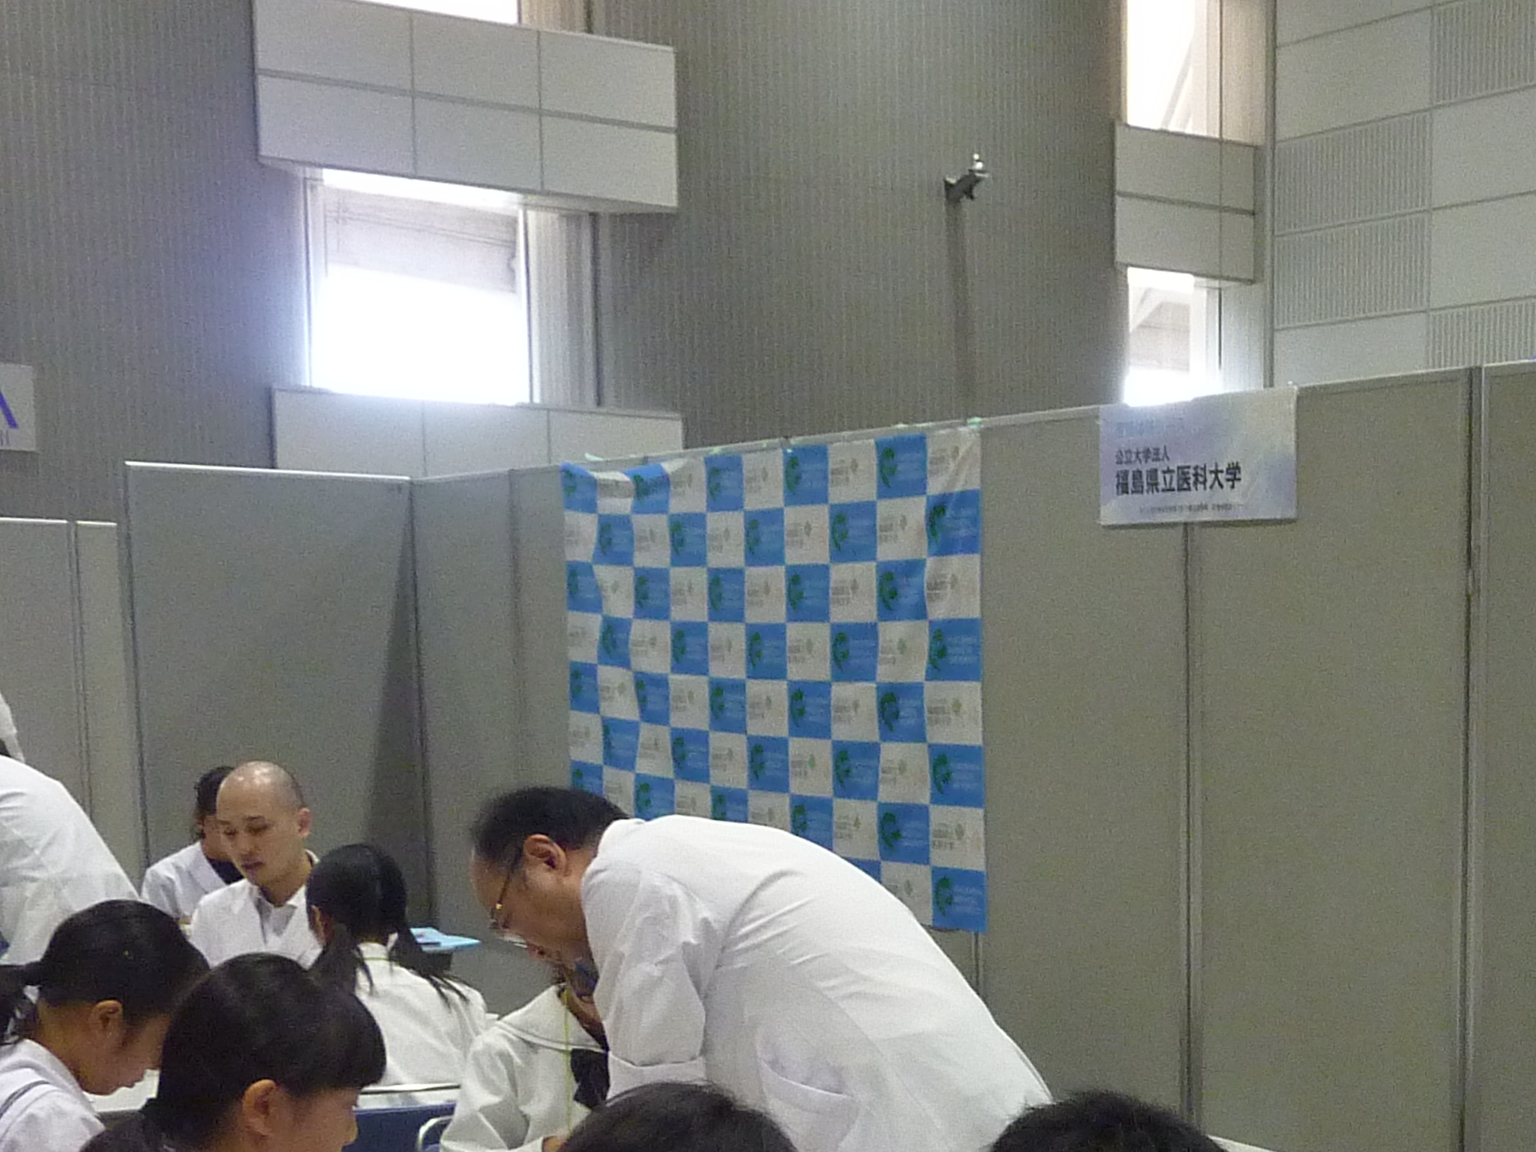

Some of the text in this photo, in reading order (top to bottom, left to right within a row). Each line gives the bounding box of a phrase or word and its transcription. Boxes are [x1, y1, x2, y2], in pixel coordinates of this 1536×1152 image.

[1115, 461, 1242, 496] 福島県立医科大学
